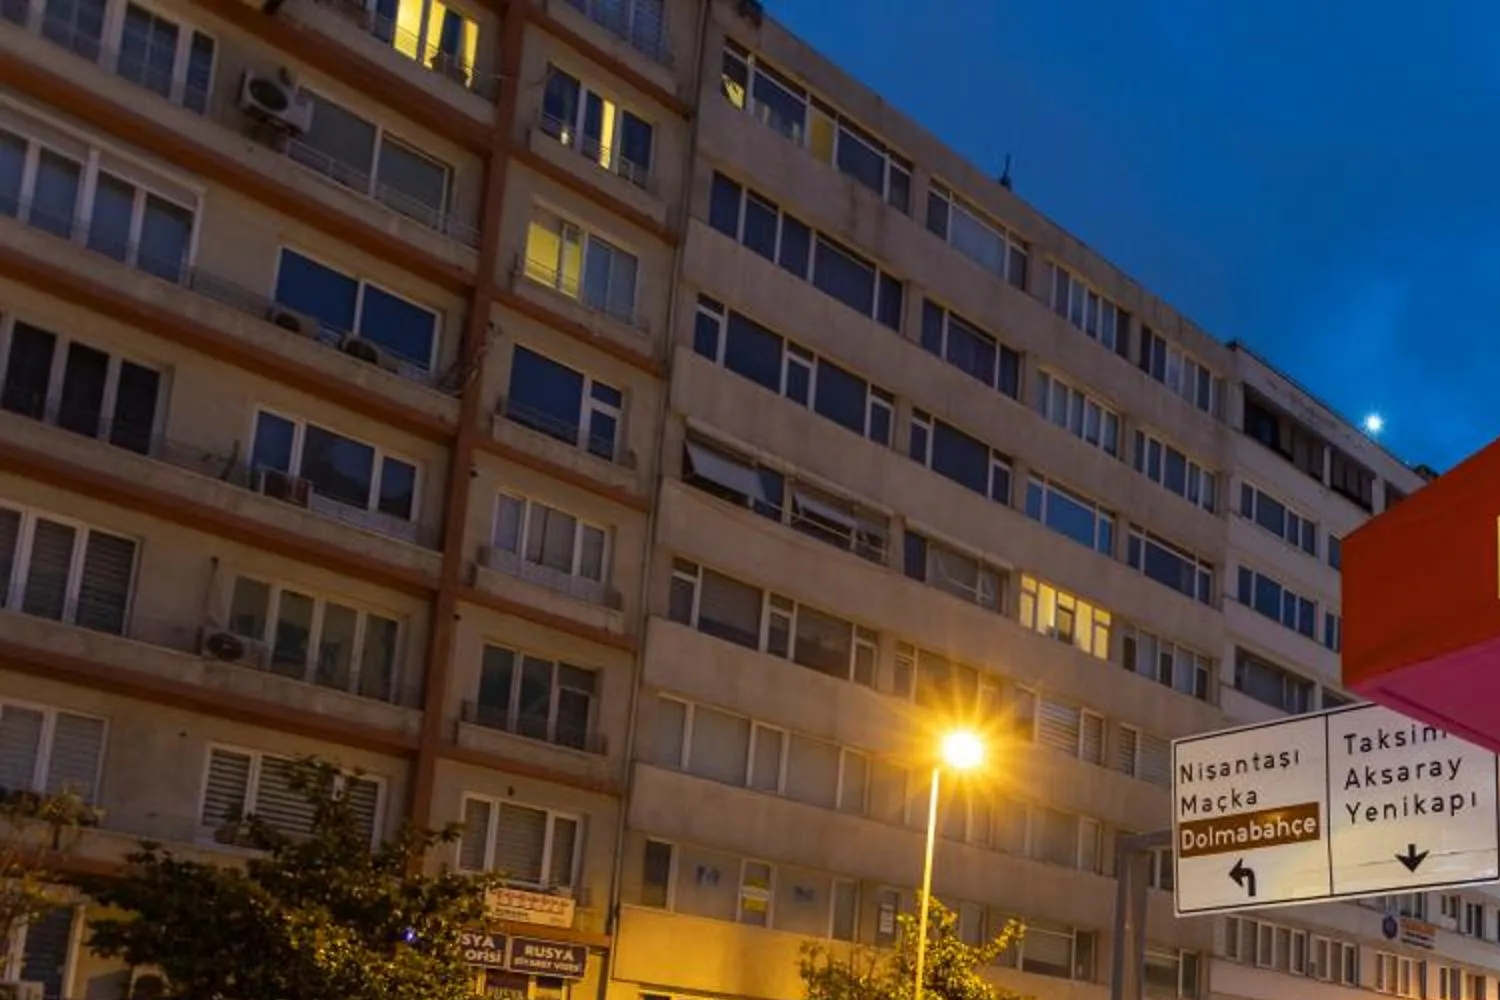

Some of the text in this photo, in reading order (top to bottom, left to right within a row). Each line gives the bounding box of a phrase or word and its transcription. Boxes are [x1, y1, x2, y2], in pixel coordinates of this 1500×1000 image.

[1180, 749, 1299, 784] Nişantaşı
[1343, 757, 1462, 790] Aksaray
[1180, 788, 1257, 816] Maçka
[1345, 791, 1477, 824] Yenikapı
[1181, 816, 1317, 851] Dolmabahçe
[524, 944, 574, 961] RUSYA
